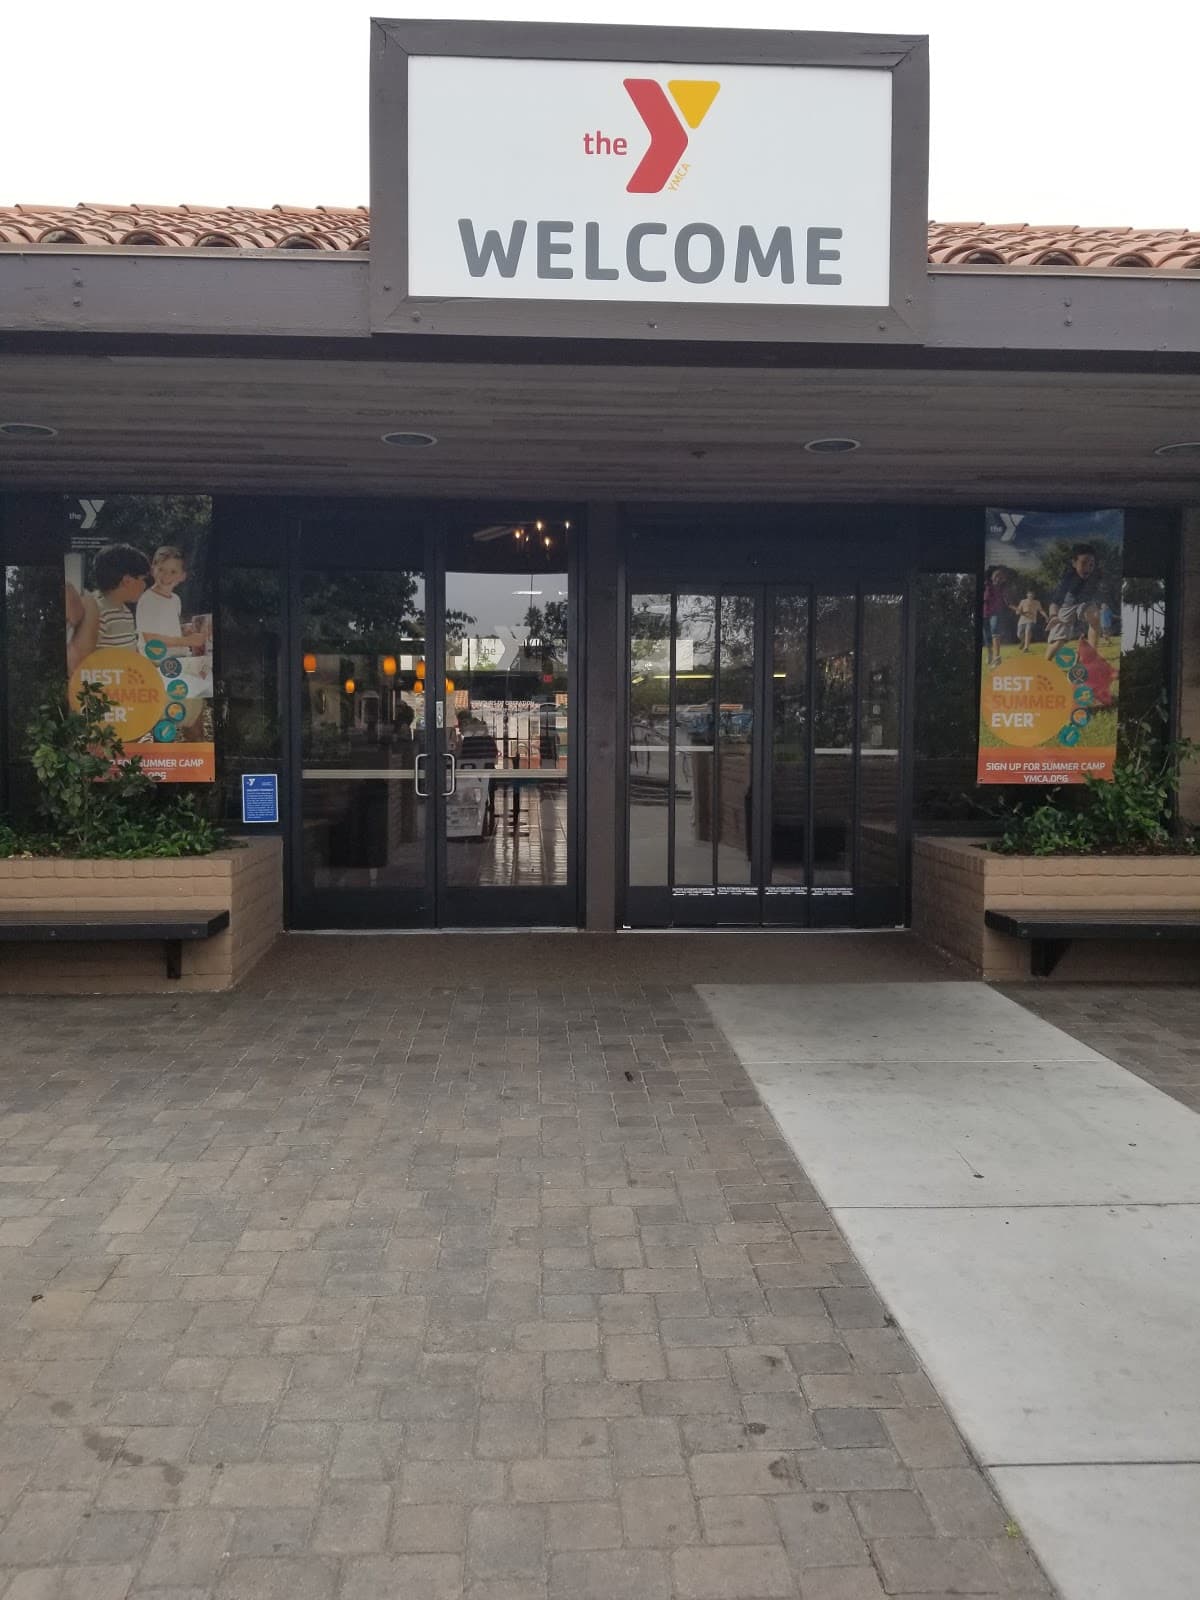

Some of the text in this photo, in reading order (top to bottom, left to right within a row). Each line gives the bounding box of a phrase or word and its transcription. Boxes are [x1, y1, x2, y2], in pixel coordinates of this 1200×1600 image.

[583, 130, 628, 156] the
[668, 162, 692, 192] YMCA
[458, 218, 843, 286] WELCOME
[80, 668, 124, 686] BEST
[992, 676, 1034, 691] BEST
[104, 687, 160, 704] MMER
[992, 694, 1067, 710] SUMMER
[992, 712, 1034, 728] EVER
[178, 759, 204, 768] CAMP
[985, 762, 1106, 771] SIGN UP FOR SUMMER CAMP
[1023, 775, 1069, 783] YMCA.ORG
